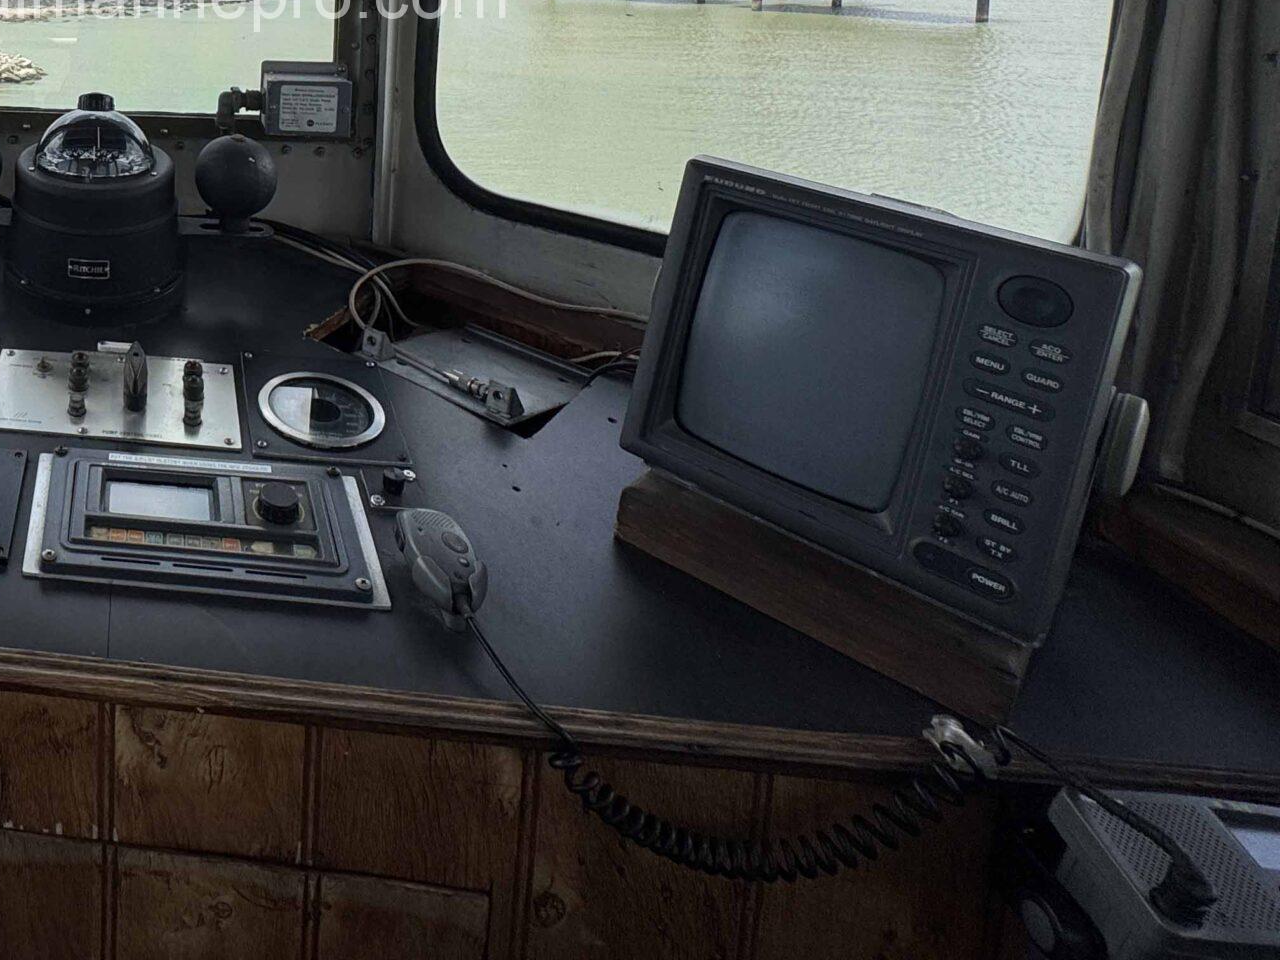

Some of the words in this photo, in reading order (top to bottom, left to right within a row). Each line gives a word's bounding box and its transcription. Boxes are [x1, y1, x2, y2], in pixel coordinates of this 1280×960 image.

[704, 174, 767, 195] FURUNO
[982, 333, 1010, 346] CANCEL
[983, 325, 1014, 339] SELECT
[1036, 349, 1063, 362] ENTER
[975, 356, 1005, 371] MENU
[1026, 373, 1060, 389] GUARD
[991, 391, 1026, 409] RANGE
[963, 416, 986, 428] SELECT
[1011, 434, 1041, 449] CONTROL
[1010, 459, 1030, 473] TLL
[995, 485, 1009, 495] A/C
[1010, 490, 1029, 503] AUTO
[991, 514, 1018, 531] BRILL
[971, 573, 1006, 592] POWER
